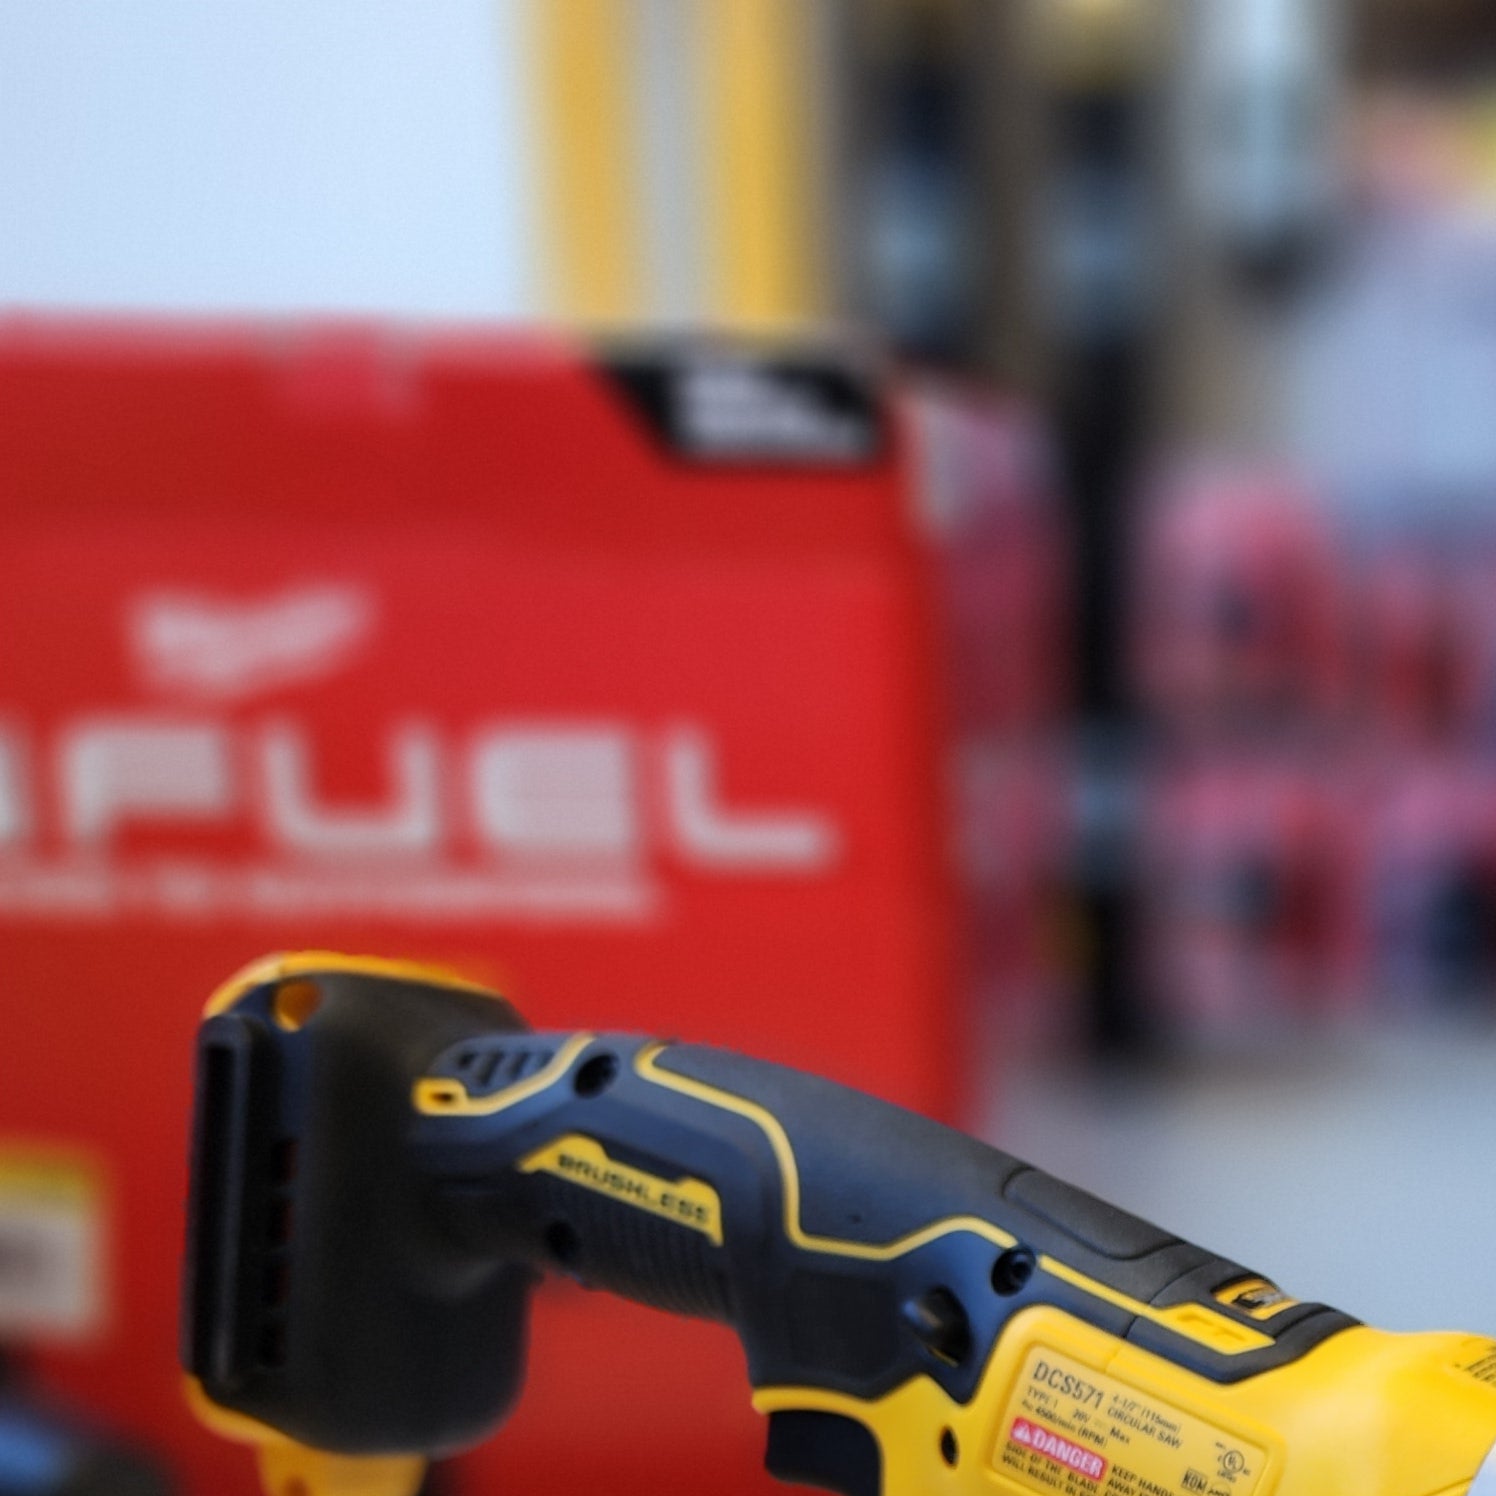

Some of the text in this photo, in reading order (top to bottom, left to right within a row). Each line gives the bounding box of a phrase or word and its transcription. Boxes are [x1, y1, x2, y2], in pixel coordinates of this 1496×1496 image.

[557, 1153, 709, 1223] BRUSHLESS
[1033, 1361, 1104, 1407] DCS571
[1027, 1386, 1050, 1403] TYPE
[1109, 1426, 1132, 1443] Max
[1106, 1406, 1182, 1448] CIRCULAR SAW
[1031, 1428, 1104, 1476] DANGER
[1077, 1426, 1108, 1447] (RPM)
[1002, 1454, 1024, 1470] WILL
[1027, 1466, 1063, 1488] RESULT
[1064, 1484, 1077, 1495] IN
[1005, 1441, 1026, 1456] SIDE
[1029, 1453, 1041, 1464] OF
[1044, 1460, 1061, 1474] THE
[1111, 1465, 1136, 1482] KEEP
[1107, 1478, 1135, 1496] AWAY
